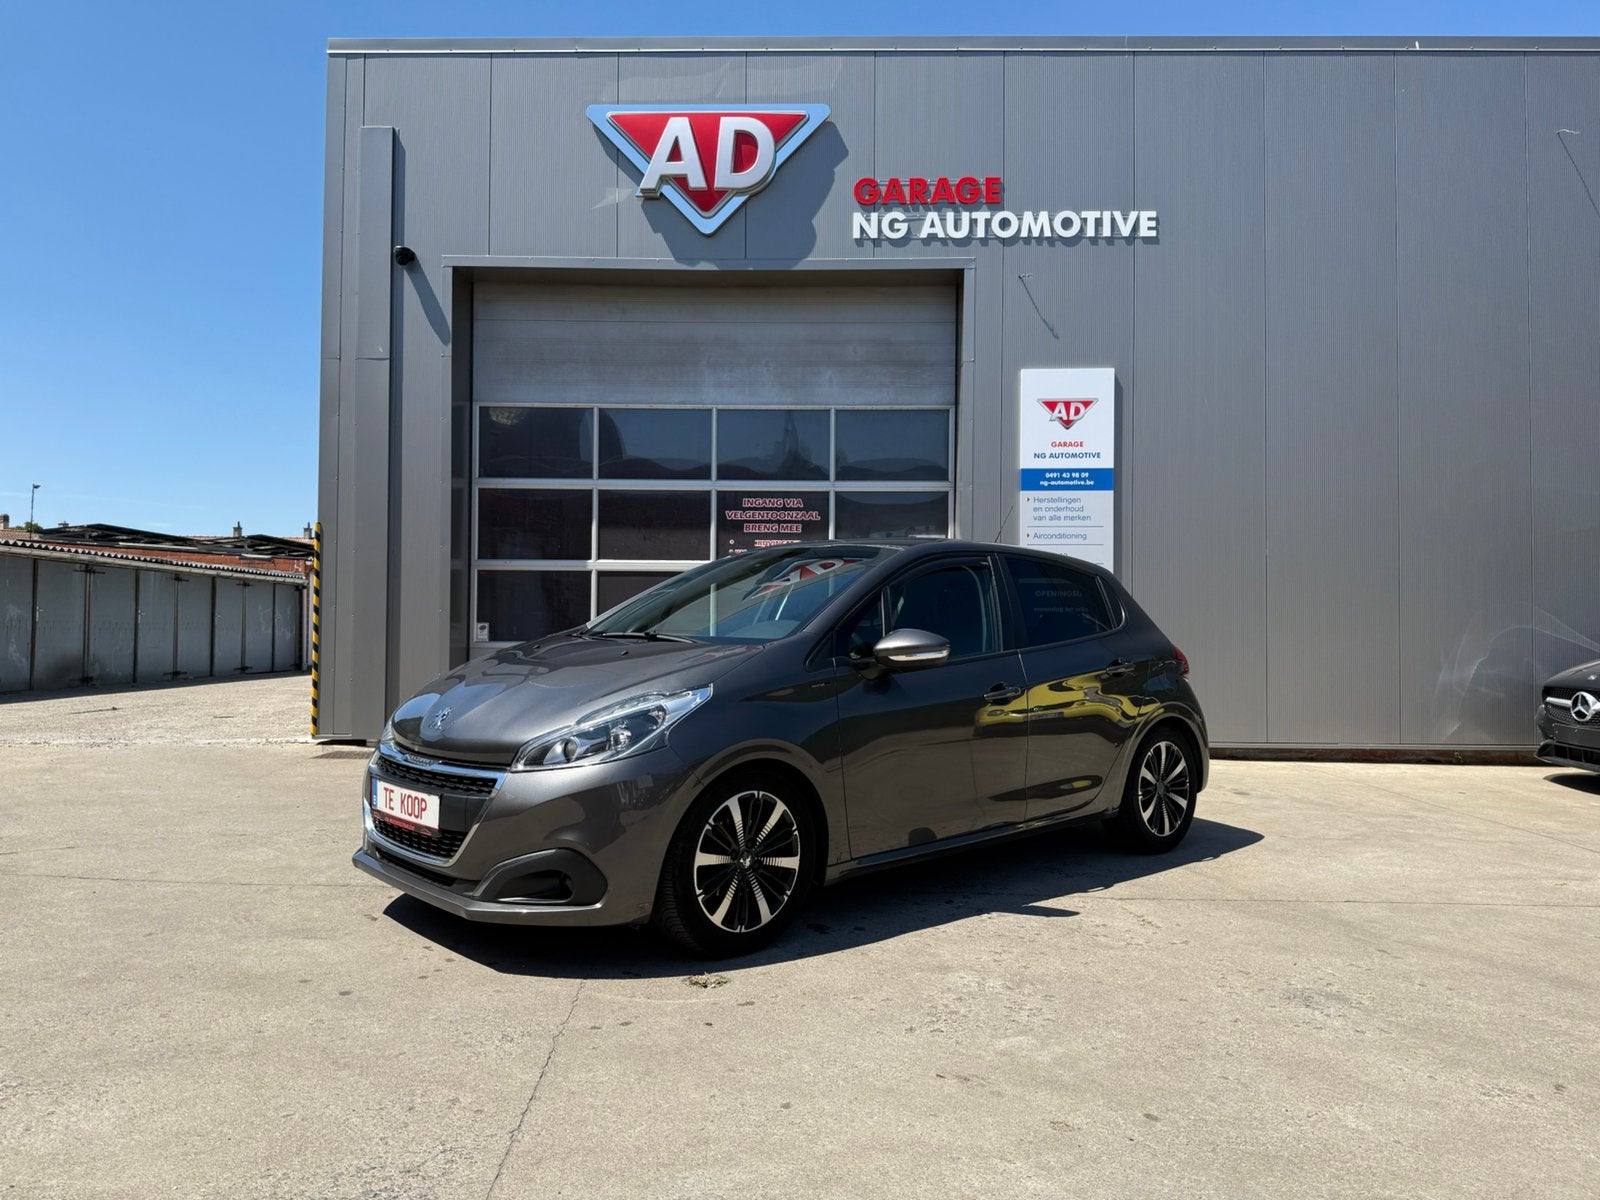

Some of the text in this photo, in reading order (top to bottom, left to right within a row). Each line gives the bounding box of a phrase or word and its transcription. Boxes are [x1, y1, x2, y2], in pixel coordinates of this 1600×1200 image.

[637, 115, 777, 196] AD
[853, 177, 1003, 206] GARAGE
[852, 210, 1158, 241] NG AUTOMOTIVE
[1050, 402, 1086, 422] AD
[1040, 479, 1095, 487] ng-automotive.be
[742, 498, 804, 508] INGANG VIA
[1033, 496, 1081, 505] Herstellingen
[1044, 505, 1084, 513] onderhoud
[725, 510, 821, 521] VELGENTOONZAAL
[1048, 514, 1061, 522] alle
[1063, 514, 1091, 522] merken
[743, 523, 802, 533] BRENG MEE
[1033, 532, 1087, 541] Airconditioning
[383, 787, 427, 820] TE KOOP
